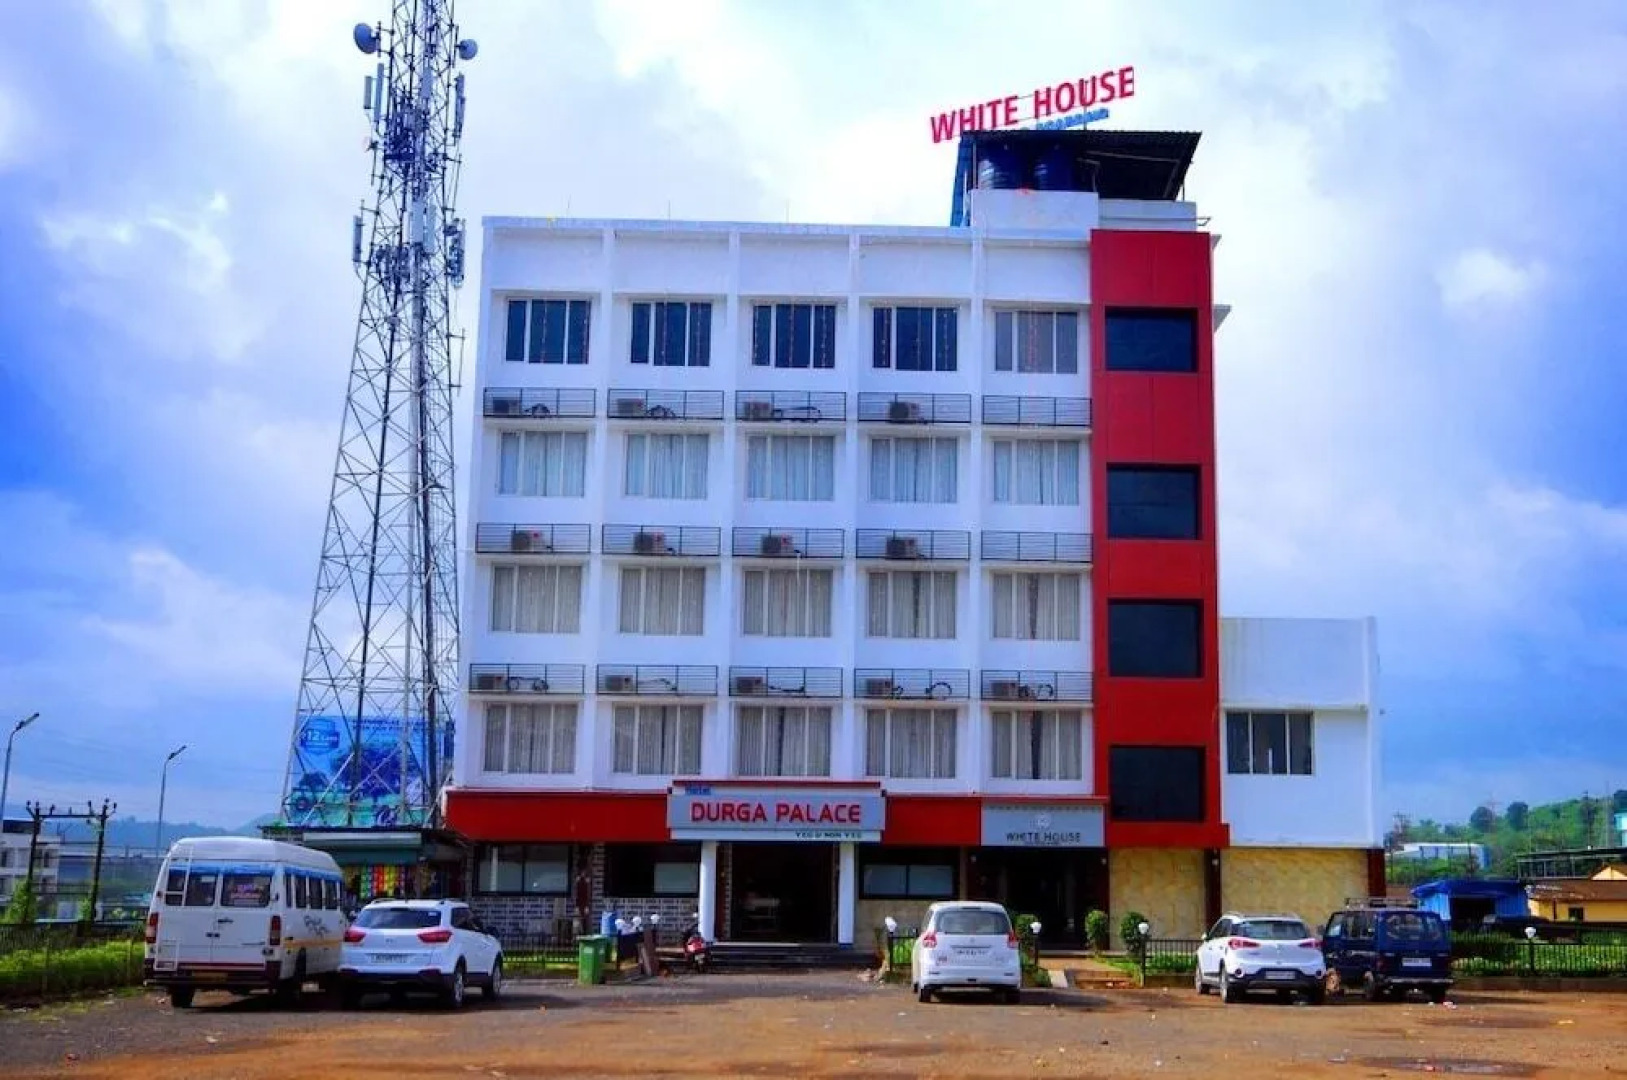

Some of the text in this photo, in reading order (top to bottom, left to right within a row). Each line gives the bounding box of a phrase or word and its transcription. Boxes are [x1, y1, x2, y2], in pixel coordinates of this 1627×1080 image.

[930, 95, 1018, 143] WHITE
[1034, 66, 1134, 119] HOUSE
[691, 802, 861, 823] DURGA PALACE
[1005, 832, 1081, 842] WHITE HOUSE
